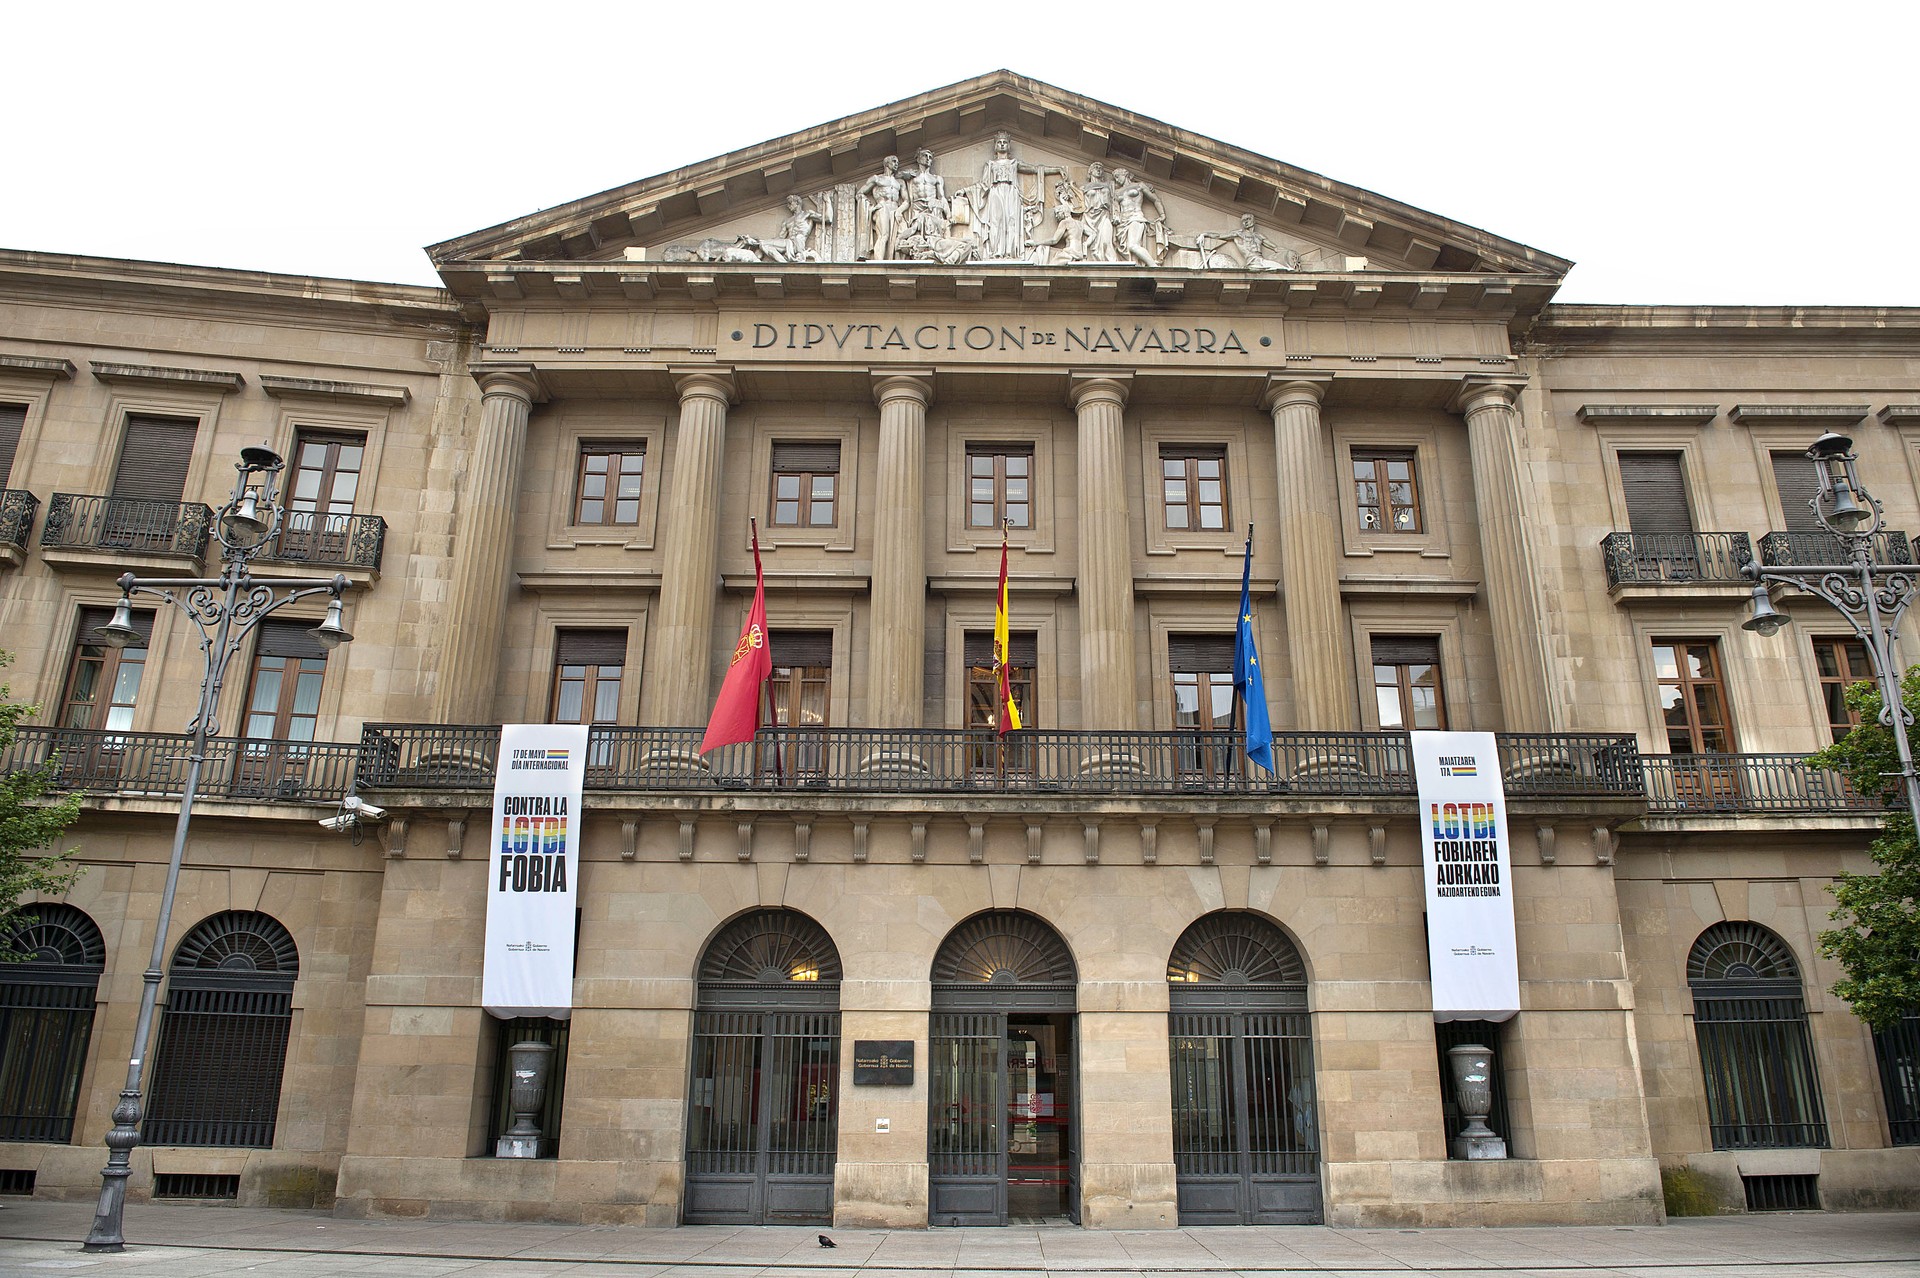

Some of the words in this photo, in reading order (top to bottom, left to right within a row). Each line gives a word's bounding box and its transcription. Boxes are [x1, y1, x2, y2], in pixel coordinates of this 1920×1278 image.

[752, 323, 1026, 351] DIPVTACION
[1032, 332, 1056, 345] DE
[1064, 326, 1248, 354] NAVARRA
[513, 749, 520, 759] 17
[520, 749, 528, 759] DE
[528, 749, 546, 759] MAYO
[1438, 756, 1476, 766] MAIATZAREN
[511, 759, 522, 770] DÍA
[522, 760, 569, 770] INTERNACIONAL
[1440, 767, 1451, 777] 17A
[503, 796, 551, 816] CONTRA
[553, 796, 568, 816] LA
[1431, 803, 1496, 839] LGTBI
[501, 816, 567, 854] LGTBI
[1434, 841, 1498, 862] FOBIAREN
[499, 855, 567, 893] FOBIA
[1437, 863, 1500, 885] AURKAKO
[1437, 887, 1480, 898] NAZIOARTEKO
[1480, 886, 1501, 897] EGUNA
